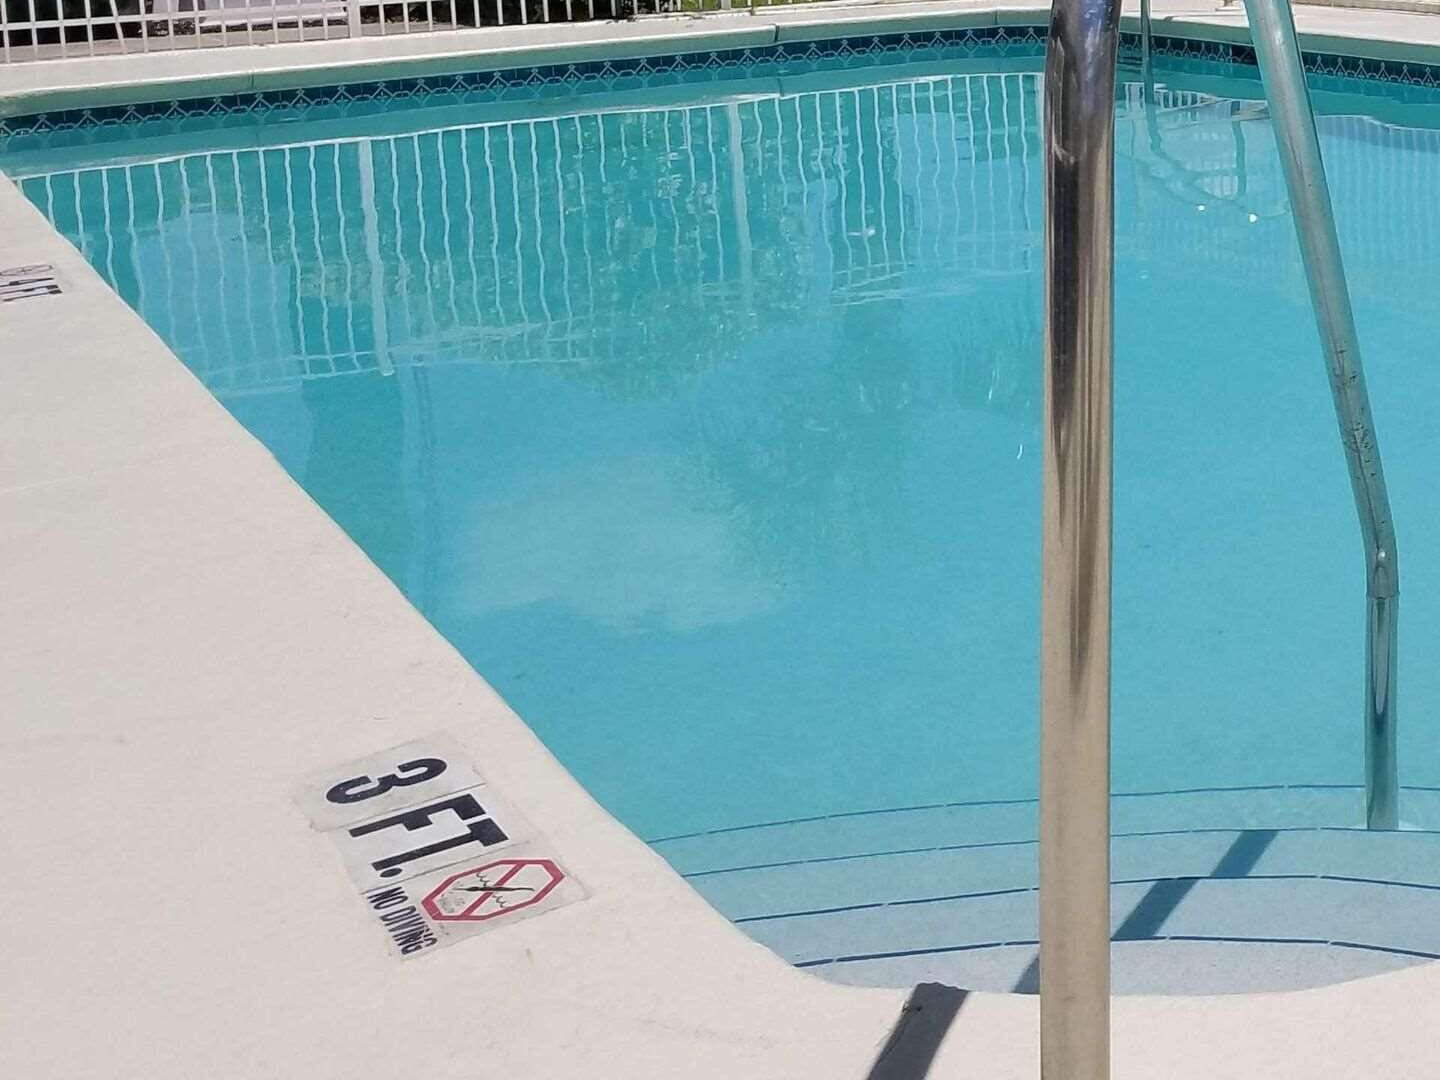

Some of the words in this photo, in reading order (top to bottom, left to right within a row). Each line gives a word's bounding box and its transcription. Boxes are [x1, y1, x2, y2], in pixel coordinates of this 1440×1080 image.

[326, 758, 447, 804] 3
[367, 886, 409, 910] NO
[379, 905, 438, 955] DIVING
